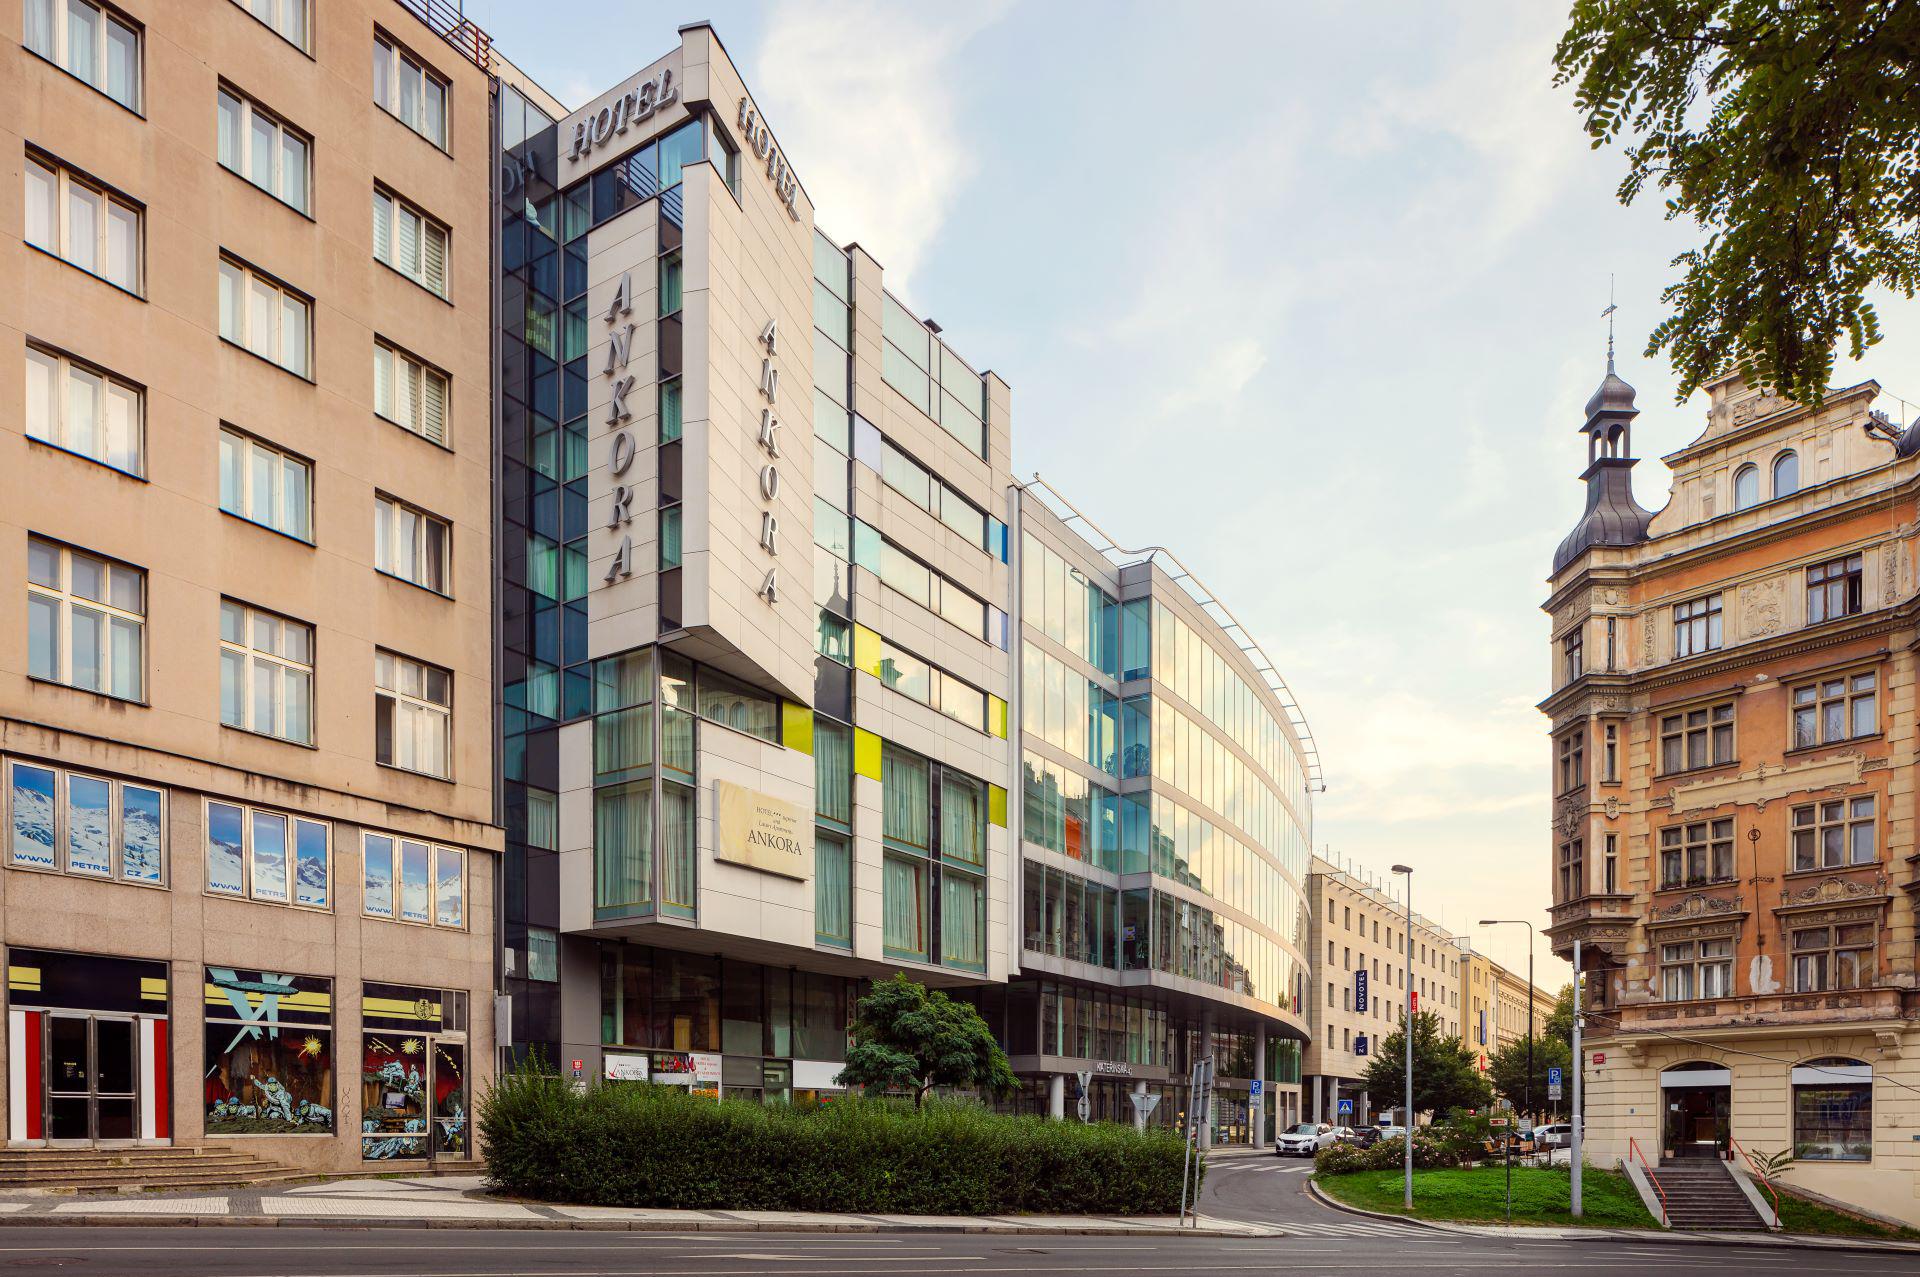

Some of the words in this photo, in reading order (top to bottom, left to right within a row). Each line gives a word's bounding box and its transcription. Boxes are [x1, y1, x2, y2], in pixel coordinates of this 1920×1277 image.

[567, 68, 678, 162] HOTEL
[737, 97, 800, 222] HOTEL
[603, 271, 636, 582] ANKORA
[758, 319, 781, 606] ANKORA
[71, 861, 109, 872] PETRS
[747, 829, 802, 856] ANKORA
[1551, 1070, 1559, 1080] P
